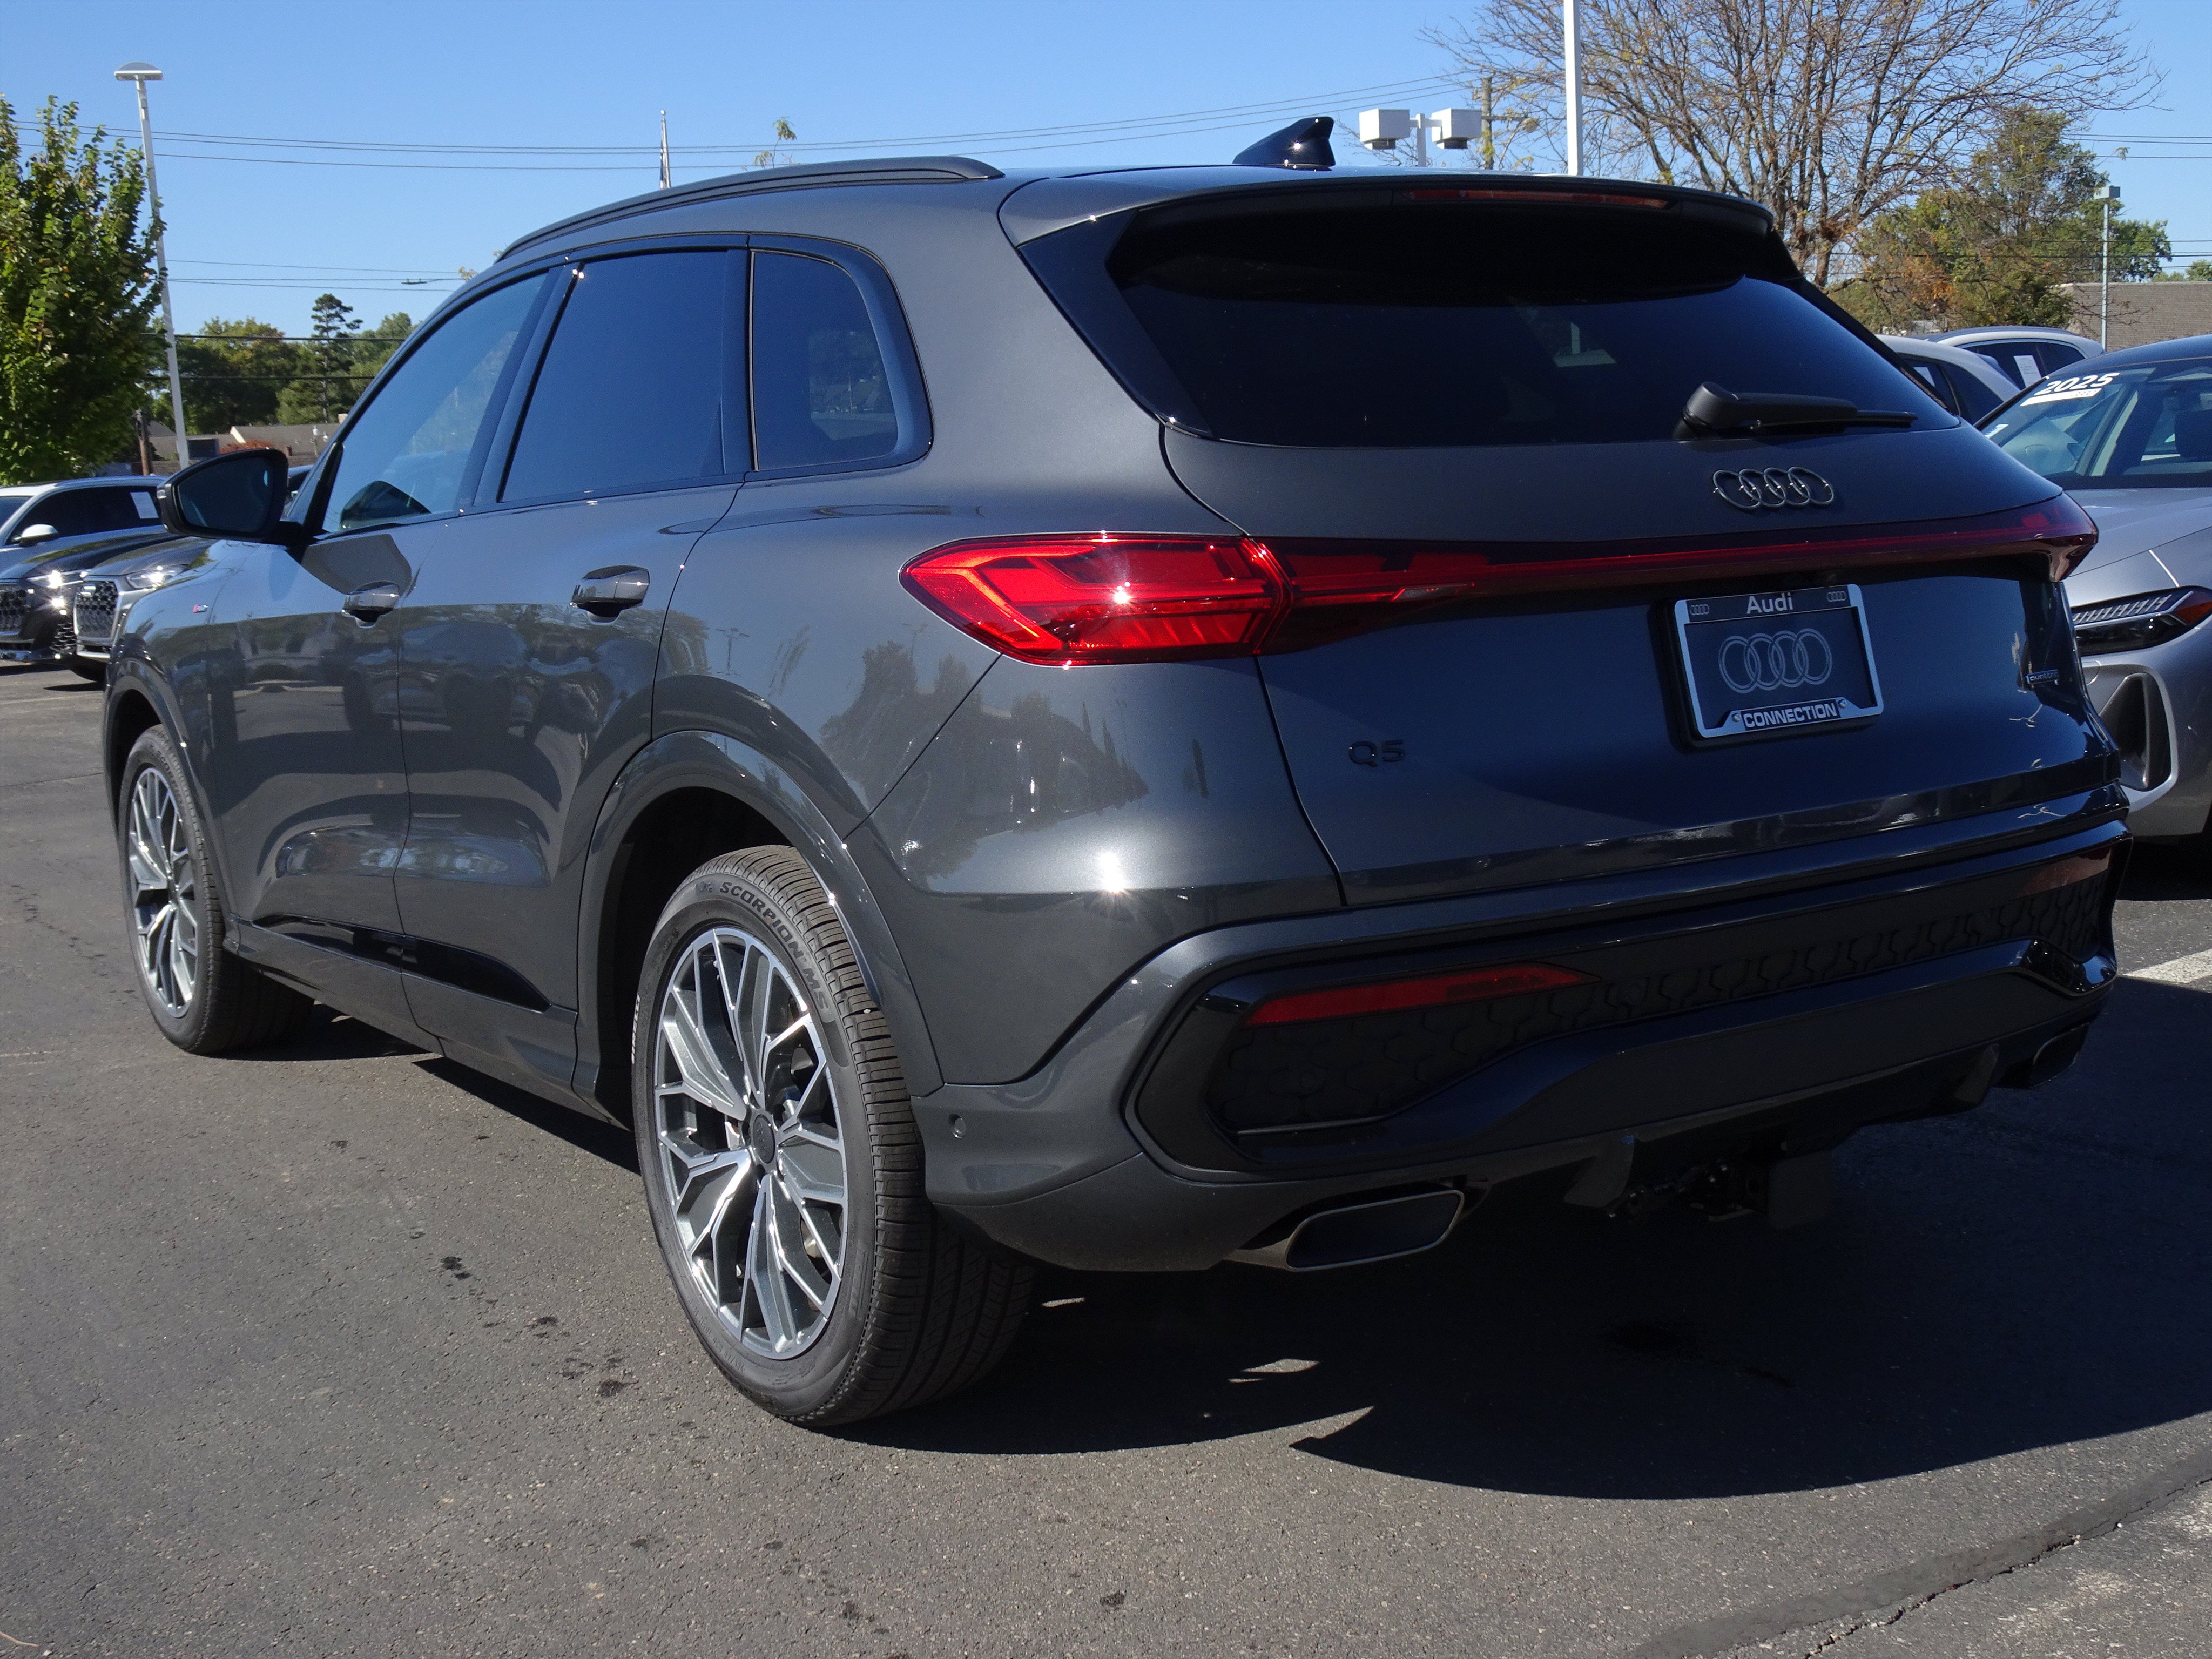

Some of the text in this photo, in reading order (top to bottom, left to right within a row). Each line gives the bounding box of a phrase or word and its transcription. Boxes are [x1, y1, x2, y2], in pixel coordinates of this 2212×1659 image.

[2034, 373, 2120, 396] 2025
[1746, 592, 1793, 614] Audi
[1743, 703, 1837, 728] CONNECTION
[1348, 739, 1404, 767] Q5
[720, 881, 804, 959] SCORPION
